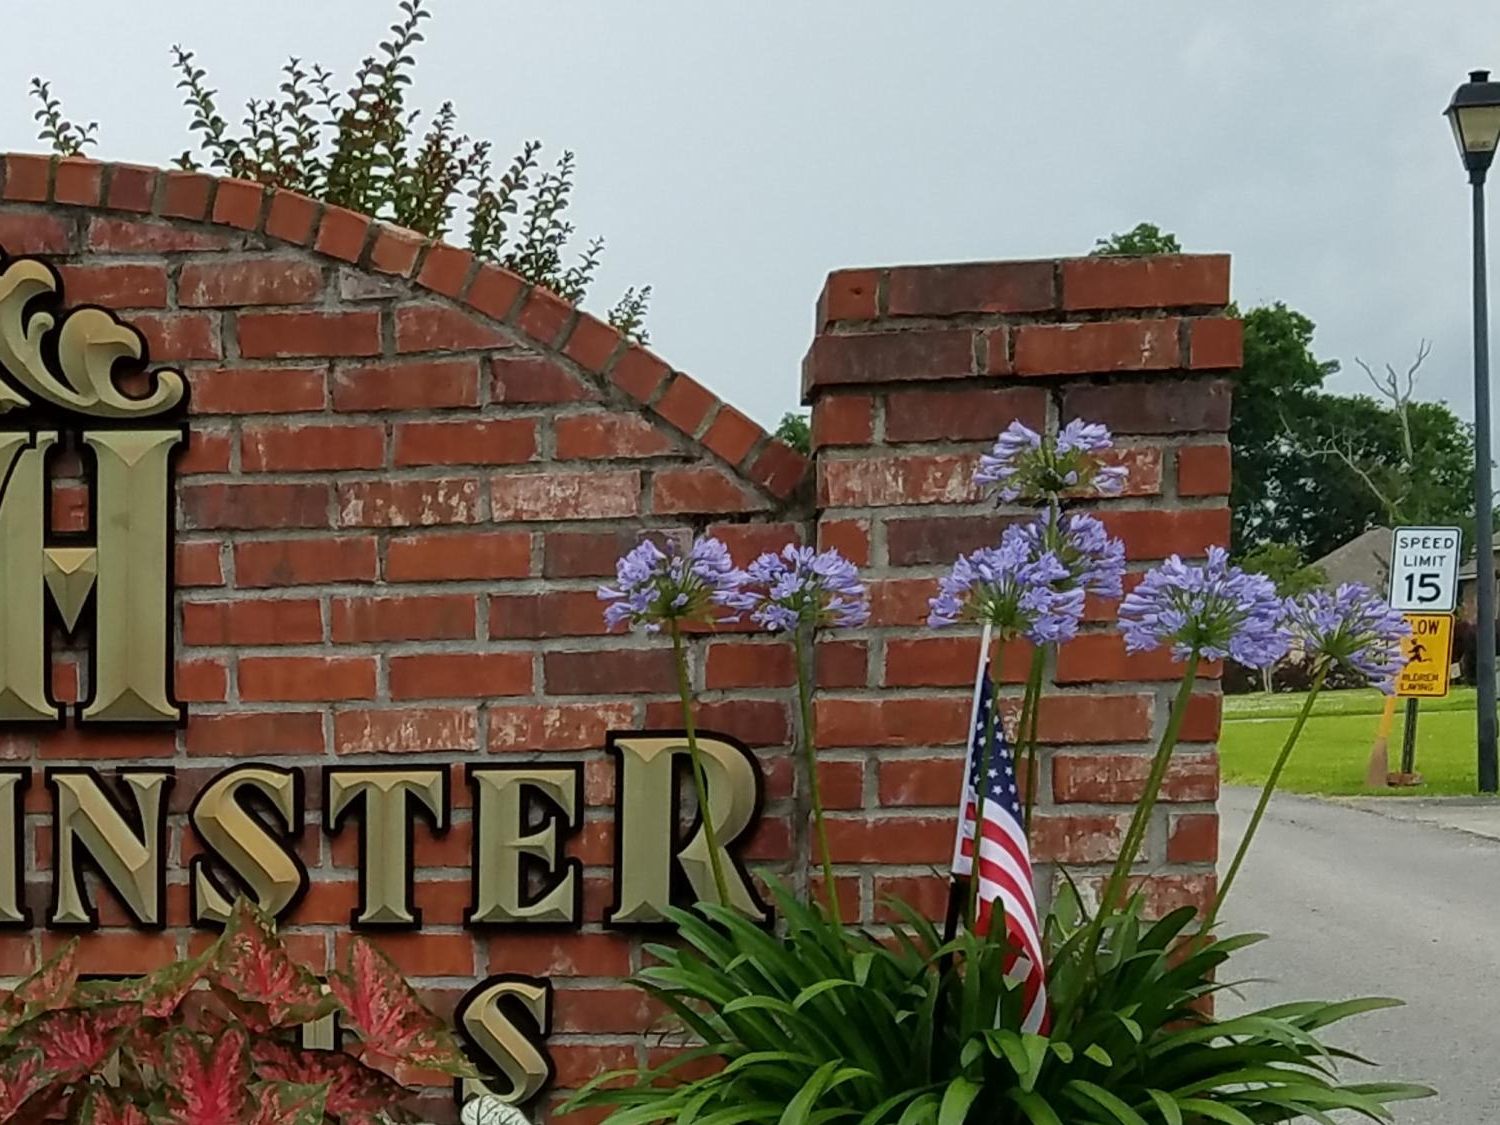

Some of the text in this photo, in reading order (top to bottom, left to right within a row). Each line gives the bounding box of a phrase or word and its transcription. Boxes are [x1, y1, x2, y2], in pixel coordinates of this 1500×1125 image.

[1399, 536, 1455, 550] SPEED
[1403, 555, 1447, 568] LIMIT
[1404, 572, 1442, 603] 15
